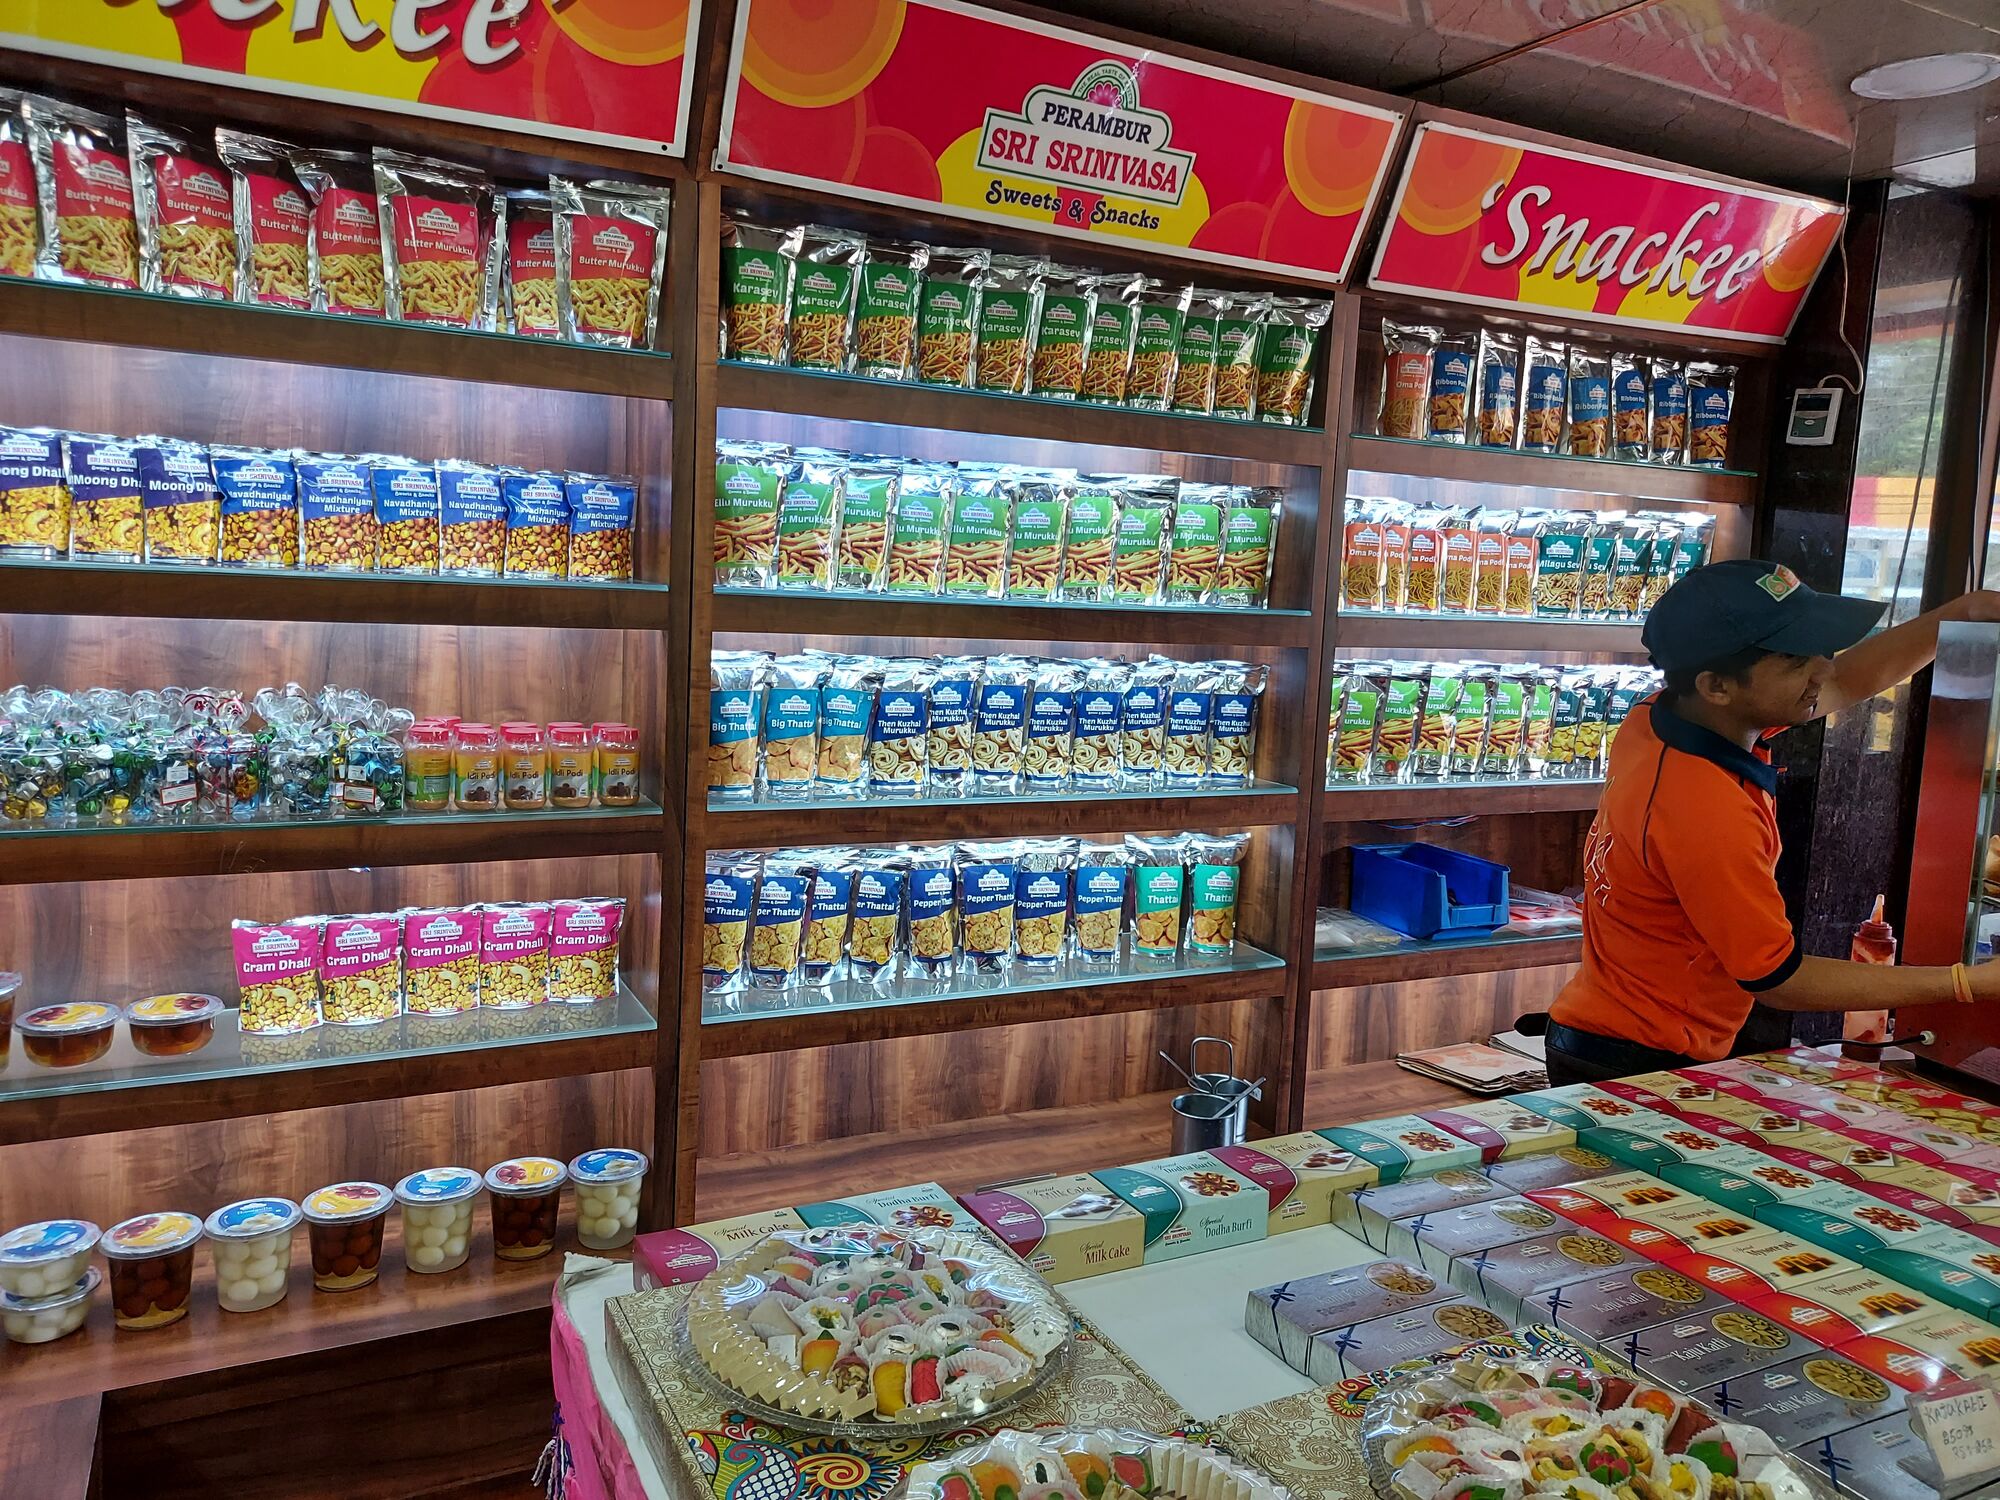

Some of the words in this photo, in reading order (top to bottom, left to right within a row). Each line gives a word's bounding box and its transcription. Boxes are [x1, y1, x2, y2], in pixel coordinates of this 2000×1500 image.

[1042, 102, 1152, 144] PERAMBUR
[988, 127, 1039, 164] SRI
[1046, 139, 1178, 193] SRINIVASA
[65, 189, 103, 202] Butter
[167, 200, 201, 213] Butter
[985, 180, 1062, 213] Sweets
[1068, 199, 1084, 224] &
[1090, 200, 1160, 230] Snacks
[261, 218, 289, 231] Butter
[323, 230, 353, 242] Butter
[404, 238, 434, 249] Butter
[435, 241, 473, 256] Murukku
[517, 260, 541, 268] Butter
[580, 256, 607, 266] Butter
[608, 259, 645, 273] Murukku
[732, 282, 779, 299] Karasev
[797, 296, 842, 309] Karasev
[868, 296, 910, 310] Karasev
[981, 322, 1023, 334] Karasev
[1041, 326, 1081, 338] Karasev
[73, 474, 119, 489] Moong
[149, 480, 195, 493] Moong
[331, 479, 363, 488] SRINIVASA
[404, 483, 436, 492] SRINIVASA
[242, 500, 280, 510] Mixture
[308, 496, 372, 507] Navadhaniyam
[734, 498, 773, 509] Murukku
[324, 504, 360, 514] Mixture
[399, 508, 434, 518] Mixture
[464, 510, 497, 520] Mixture
[527, 514, 559, 525] Mixture
[577, 511, 628, 522] Navadhaniyam
[590, 519, 619, 529] Mixture
[967, 524, 1002, 537] Murukku
[1120, 537, 1156, 546] Murukku
[1179, 532, 1215, 542] Murukku
[1234, 535, 1267, 544] Murukku
[1567, 561, 1578, 569] Sev
[712, 722, 726, 732] Big
[771, 718, 785, 729] Big
[878, 720, 896, 728] Then
[985, 718, 1016, 726] Murukku
[1079, 718, 1097, 726] Then
[1032, 724, 1064, 732] Murukku
[1084, 724, 1114, 732] Murukku
[1171, 724, 1201, 732] Murukku
[1218, 725, 1247, 733] Murukku
[467, 771, 480, 779] Idli
[481, 771, 495, 779] Podi
[510, 771, 521, 779] Idli
[522, 771, 539, 779] Podi
[566, 769, 583, 777] Podi
[609, 768, 619, 776] Idli
[620, 767, 636, 776] Podi
[913, 899, 941, 908] Pepper
[967, 894, 993, 903] Pepper
[1078, 895, 1104, 904] Pepper
[1017, 900, 1044, 909] Pepper
[568, 918, 576, 926] SRI
[577, 917, 605, 926] SRINIVASA
[422, 928, 431, 937] SRI
[433, 926, 462, 936] SRINIVASA
[495, 925, 503, 933] SRI
[505, 922, 533, 932] SRINIVASA
[338, 937, 348, 946] SRI
[350, 935, 380, 945] SRINIVASA
[484, 941, 507, 952] Gram
[509, 937, 543, 950] Dhall
[555, 934, 577, 945] Gram
[254, 943, 265, 952] SRI
[267, 941, 298, 951] SRINIVASA
[411, 946, 435, 958] Gram
[437, 942, 472, 955] Dhall
[327, 954, 352, 966] Gram
[353, 948, 391, 963] Dhall
[243, 961, 267, 973] Gram
[269, 957, 311, 971] Dhall
[1199, 1215, 1224, 1229] Special
[726, 1230, 758, 1242] Milk
[759, 1221, 790, 1234] Cake
[1204, 1220, 1230, 1239] Dodha
[1232, 1220, 1253, 1235] Burfi
[1080, 1240, 1104, 1255] Special
[1085, 1249, 1107, 1265] Milk
[1109, 1244, 1130, 1261] Cake
[1830, 1283, 1863, 1297] Mysore
[1864, 1279, 1883, 1289] pak
[1671, 1344, 1703, 1361] Kaju
